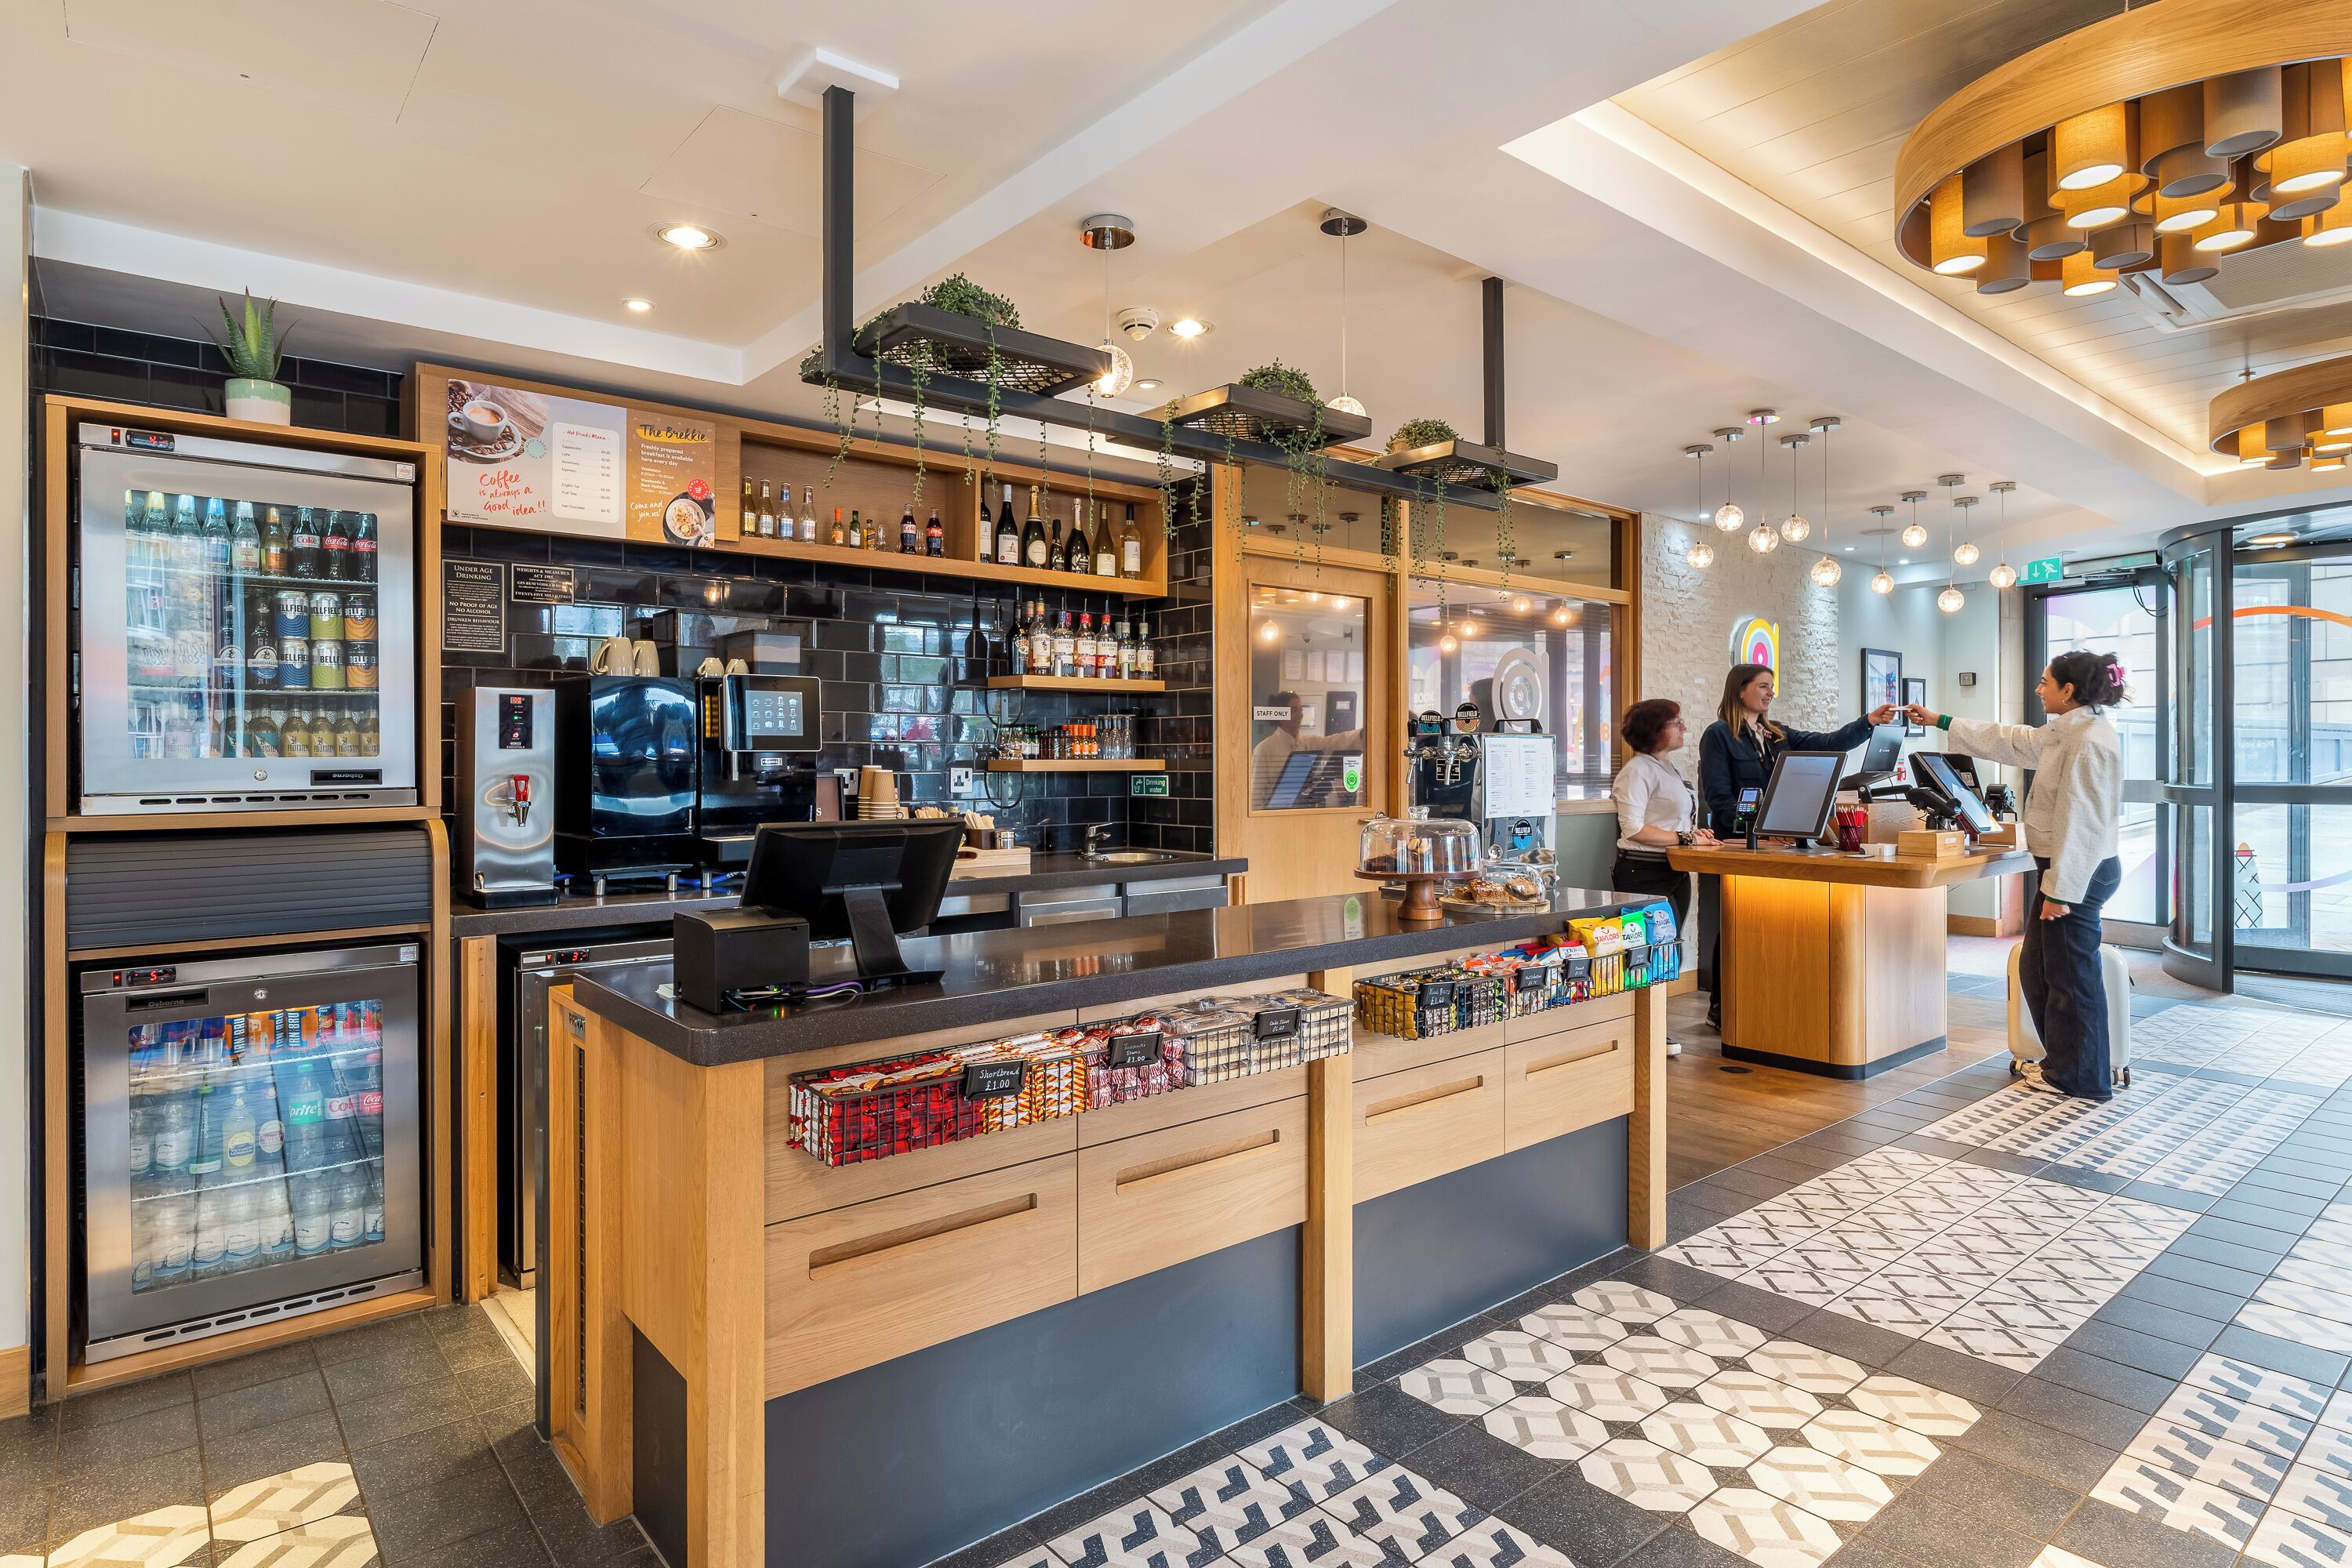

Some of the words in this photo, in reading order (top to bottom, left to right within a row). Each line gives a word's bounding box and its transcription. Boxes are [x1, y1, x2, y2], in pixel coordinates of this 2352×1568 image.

[640, 424, 662, 438] The
[666, 426, 707, 441] Brekkie
[671, 454, 693, 463] available
[479, 470, 521, 489] Coffee
[489, 489, 521, 499] always
[484, 499, 510, 513] Good
[637, 510, 650, 522] join
[454, 564, 478, 573] UNDER
[456, 572, 492, 580] DRINKING
[1595, 932, 1620, 943] TAYLORS
[1622, 931, 1643, 940] TAYLORS
[572, 952, 579, 961] 3
[150, 971, 157, 981] 5
[979, 1066, 1020, 1079] Shortbread
[985, 1079, 1010, 1091] £1.00
[289, 1104, 317, 1118] prite
